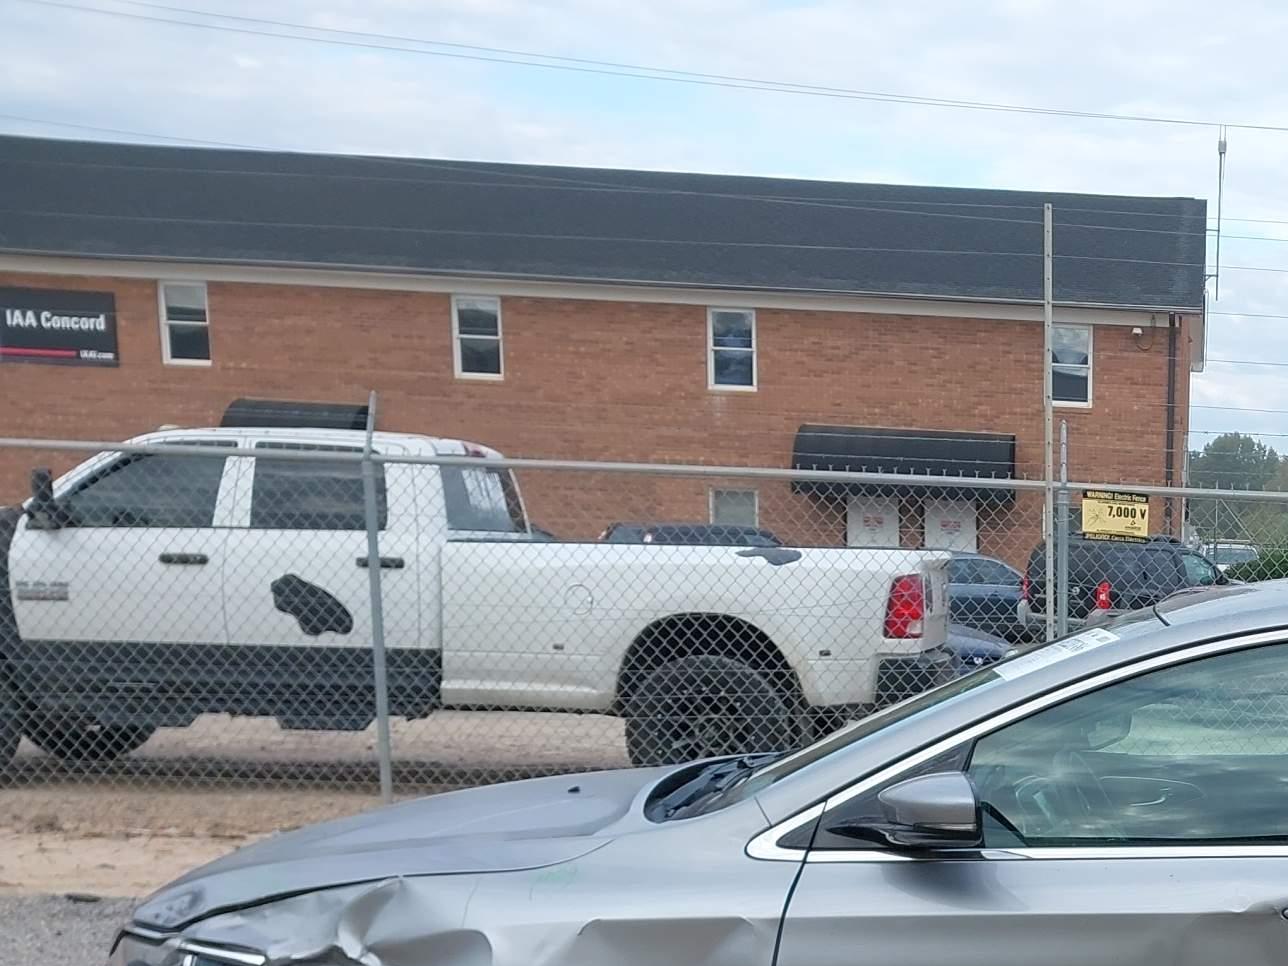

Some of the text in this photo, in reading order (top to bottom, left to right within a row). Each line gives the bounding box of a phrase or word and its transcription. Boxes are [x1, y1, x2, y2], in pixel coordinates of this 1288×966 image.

[6, 309, 105, 331] IAA Concord
[1107, 505, 1147, 520] 7,000 V
